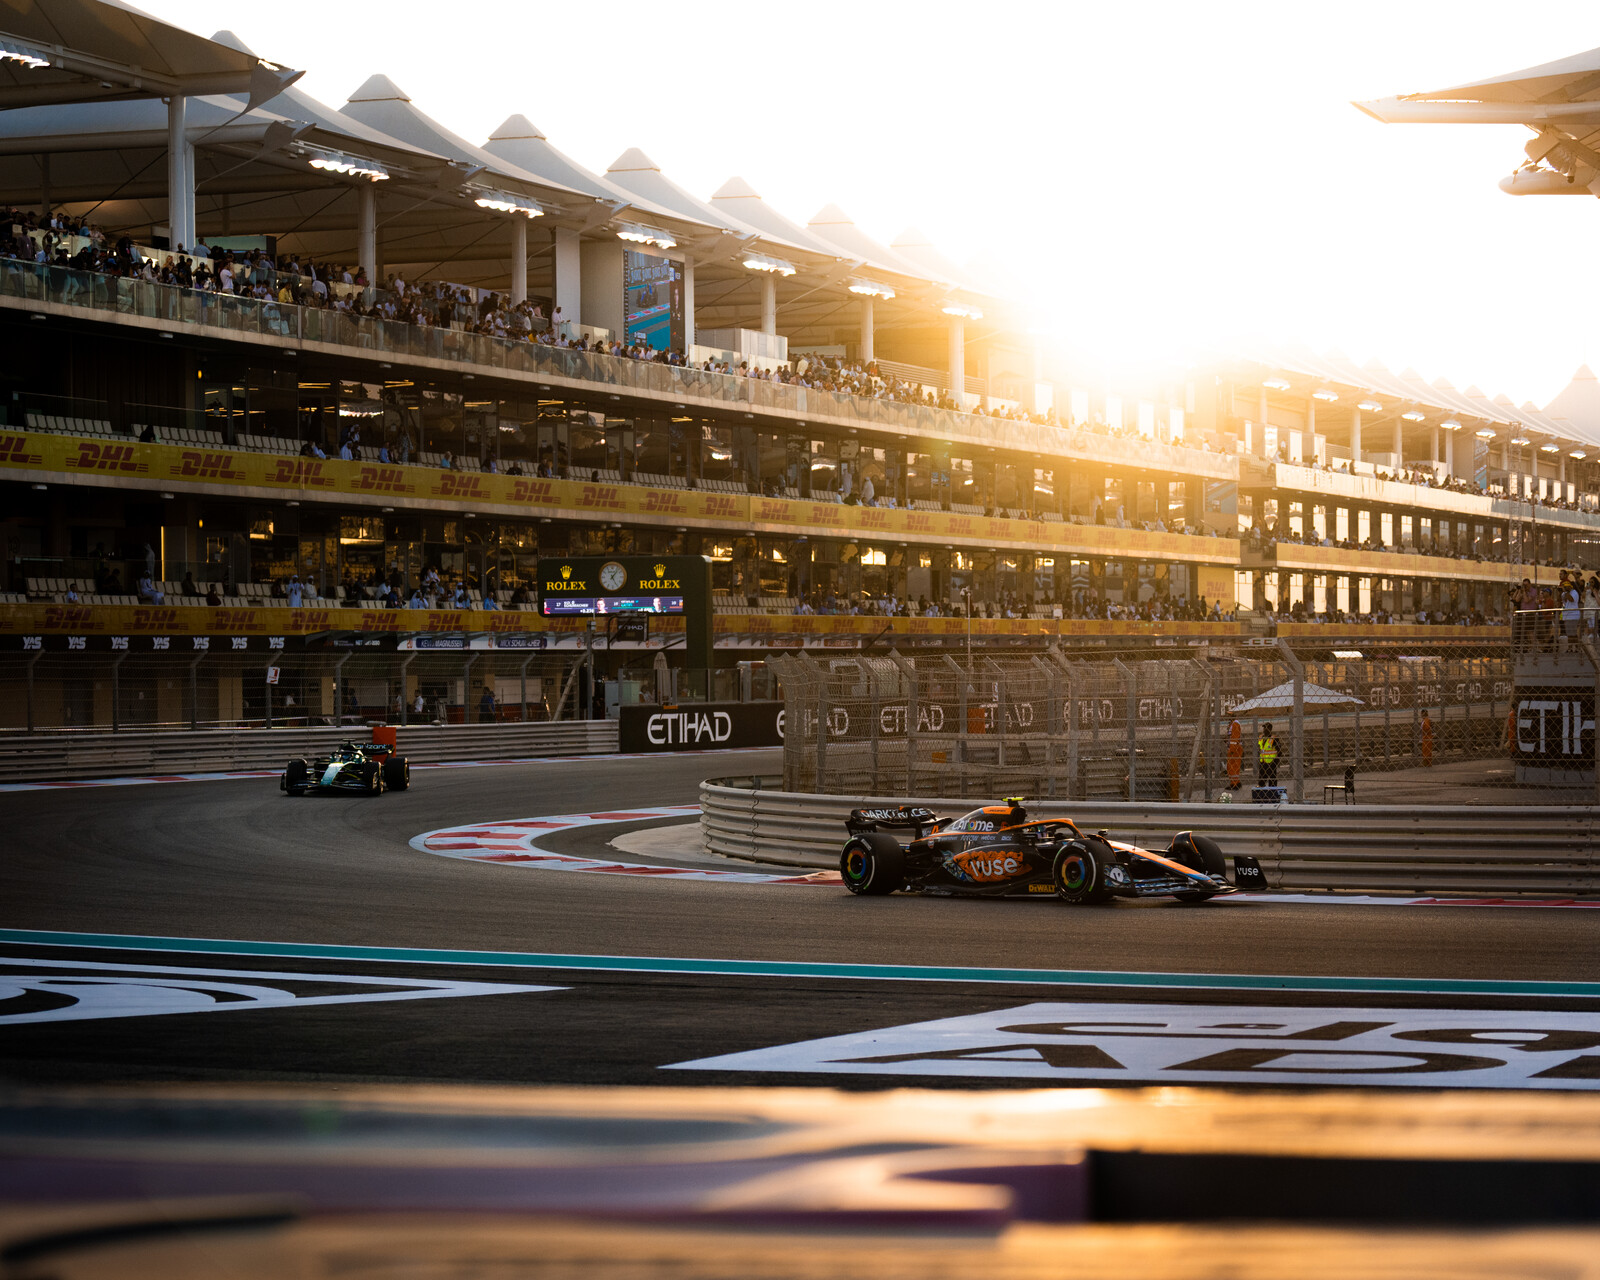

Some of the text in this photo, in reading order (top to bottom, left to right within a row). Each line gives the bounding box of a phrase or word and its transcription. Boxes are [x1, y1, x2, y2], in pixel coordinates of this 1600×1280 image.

[0, 436, 30, 463] HL
[78, 443, 137, 470] DHL
[181, 452, 236, 479] DHL
[275, 460, 325, 486] DHL
[360, 467, 407, 492] DHL
[440, 474, 482, 498] DHL
[514, 481, 553, 503] DHL
[582, 486, 619, 509] DHL
[645, 492, 681, 512] DHL
[705, 497, 738, 517] DHL
[761, 501, 790, 521] DHL
[812, 506, 840, 524] DHL
[861, 510, 887, 528] DHL
[906, 514, 931, 531] DHL
[949, 518, 973, 535] DHL
[989, 521, 1012, 537] DHL
[546, 581, 586, 591] ROLEX
[639, 580, 681, 589] ROLEX
[45, 607, 96, 629] DHL
[134, 609, 180, 630] DHL
[215, 611, 258, 631] DHL
[290, 611, 331, 631] DHL
[361, 613, 400, 632] DHL
[428, 614, 464, 632] DHL
[490, 614, 524, 632] DHL
[23, 636, 42, 649] YAS
[68, 636, 86, 649] YAS
[111, 636, 129, 649] YAS
[153, 636, 170, 649] YAS
[193, 636, 210, 649] YAS
[232, 636, 248, 649] YAS
[269, 636, 285, 649] YAS
[1371, 686, 1401, 705] ETIAD
[1456, 683, 1482, 700] ETHAD
[647, 711, 732, 744] ETIHAD
[880, 706, 944, 733] ETIAD
[861, 808, 929, 820] DARKTRCE
